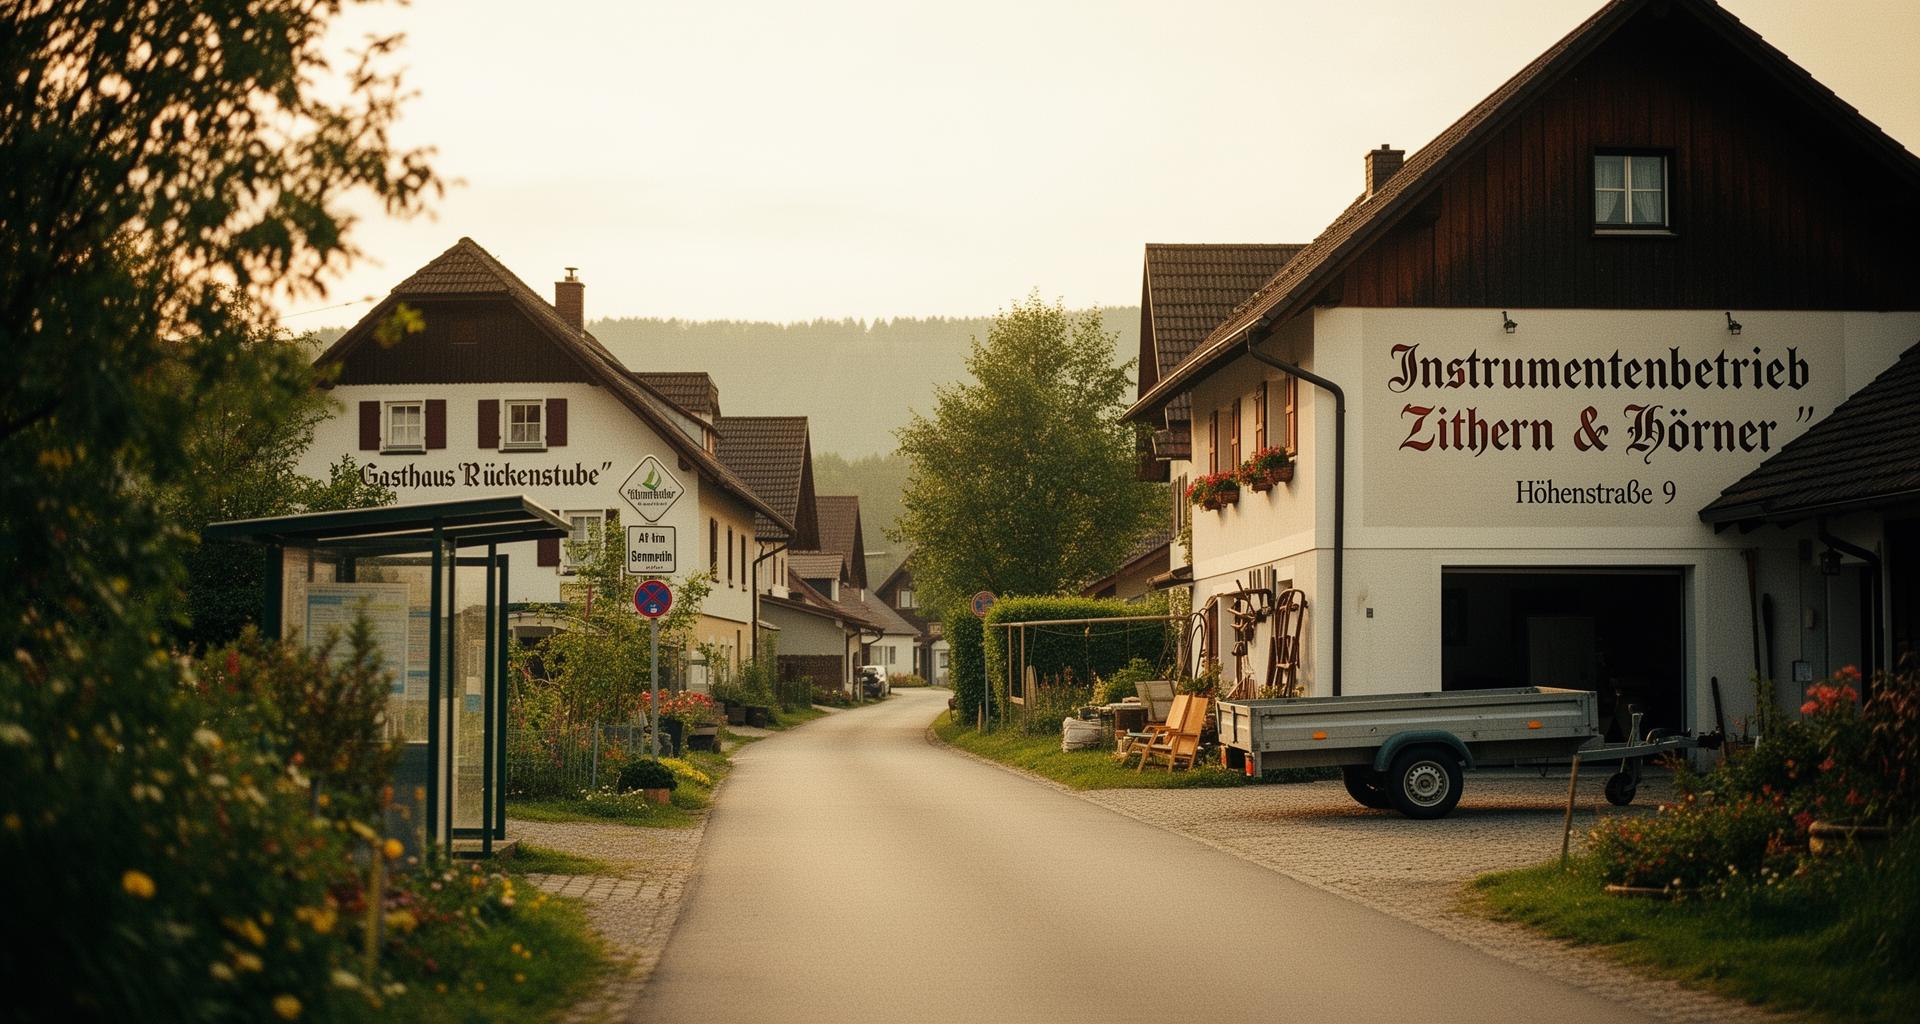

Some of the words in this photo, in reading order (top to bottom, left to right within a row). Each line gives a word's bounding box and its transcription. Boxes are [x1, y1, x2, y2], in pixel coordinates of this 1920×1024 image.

[1387, 343, 1810, 394] Instrumentenbetrieb
[1398, 403, 1555, 458] Zithern
[1573, 404, 1609, 453] &
[1623, 403, 1778, 465] Hörner
[359, 462, 456, 489] Gasthaus
[1515, 479, 1653, 505] Höhenstraße
[1662, 480, 1677, 505] 9
